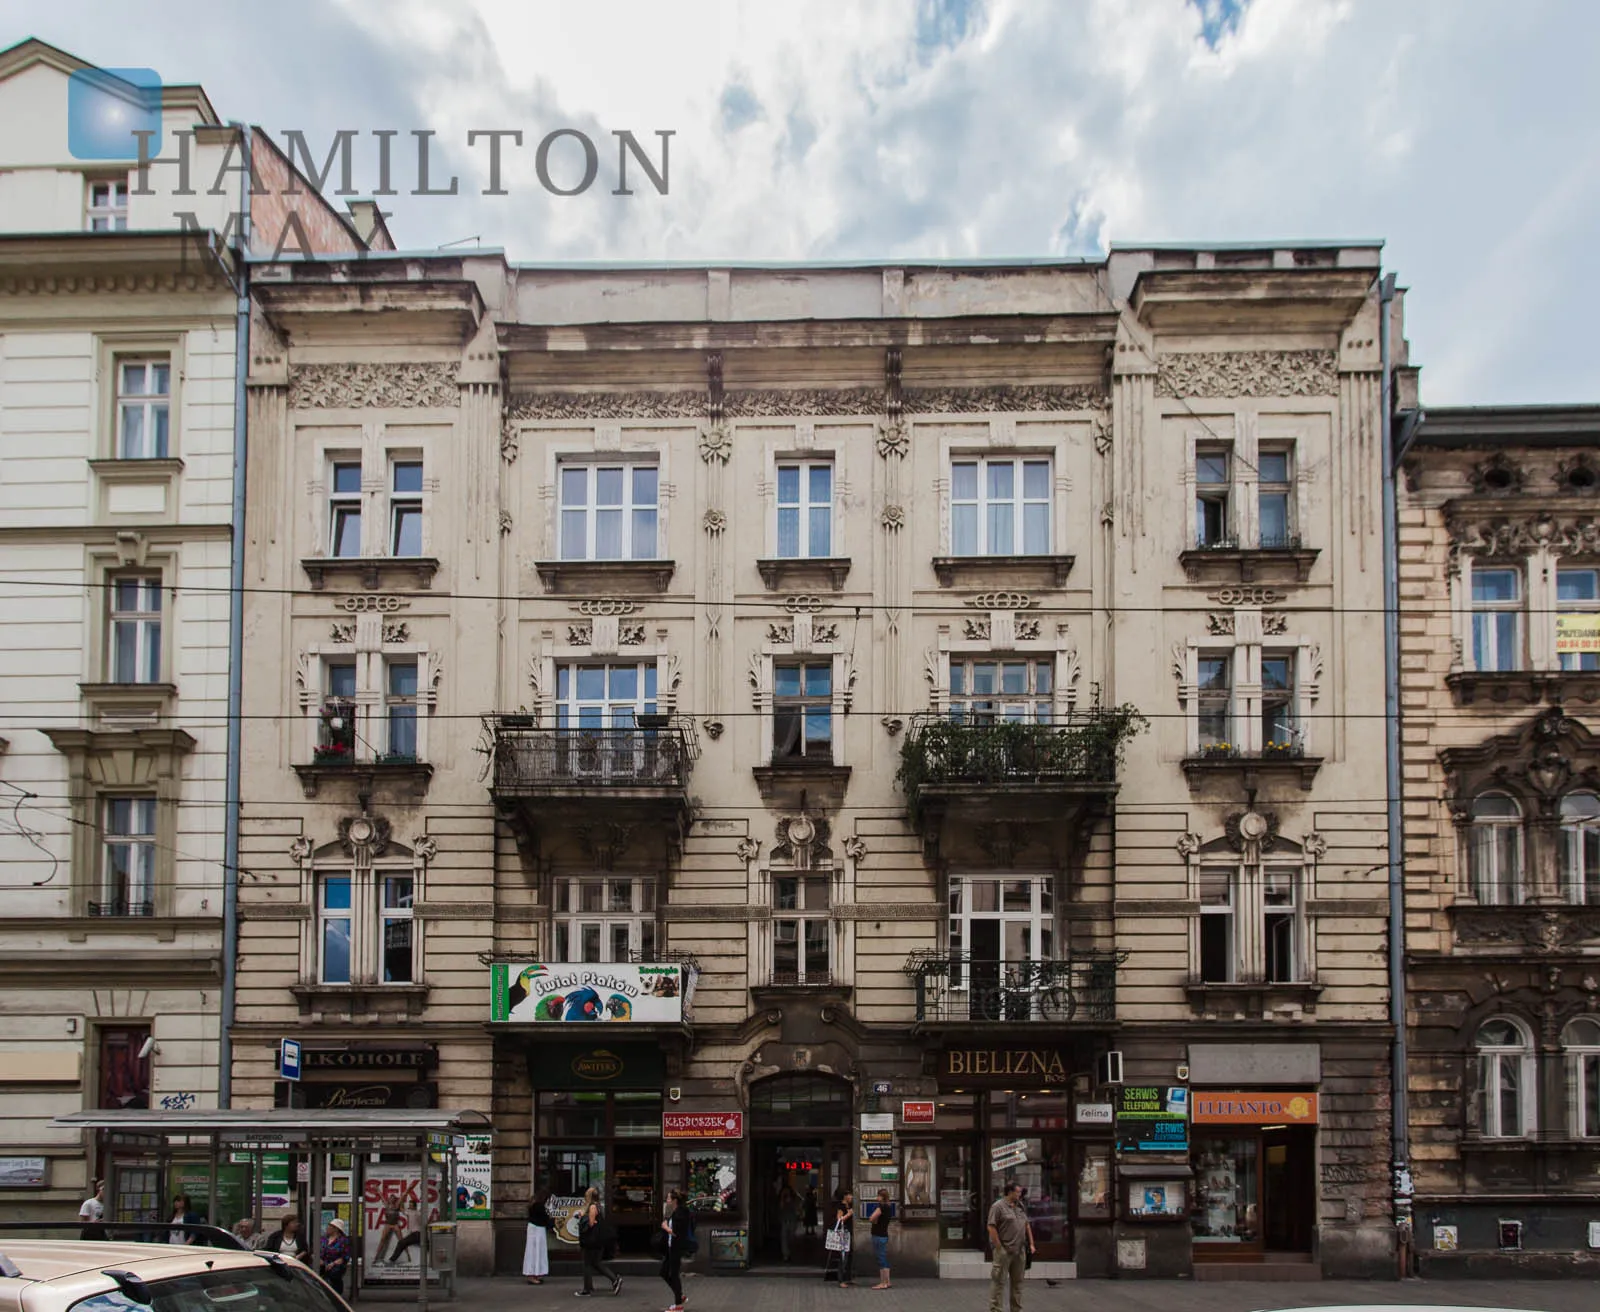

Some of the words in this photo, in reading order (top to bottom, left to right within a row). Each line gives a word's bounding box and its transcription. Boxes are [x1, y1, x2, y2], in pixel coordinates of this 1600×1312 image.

[535, 972, 577, 997] Świat
[582, 972, 639, 998] Ptaków
[303, 1052, 425, 1066] LKOHOLE
[948, 1050, 1065, 1074] BIELIZNA
[877, 1084, 888, 1093] 46
[1124, 1088, 1159, 1100] SERWIS
[1155, 1123, 1185, 1133] SERWIS
[365, 1179, 439, 1203] SEKS
